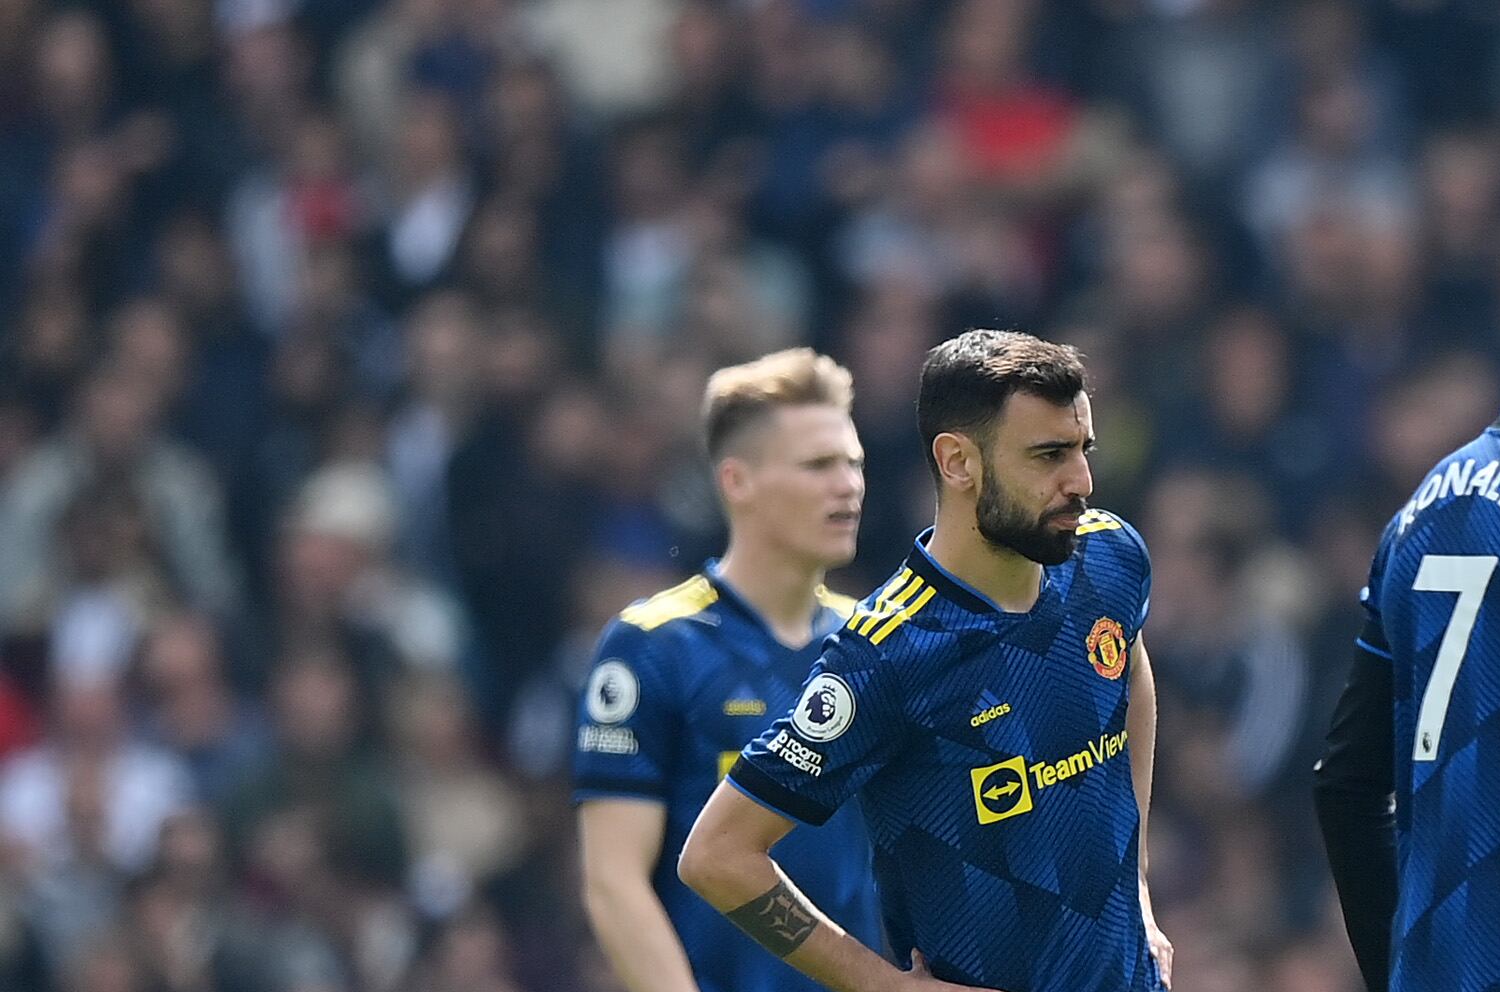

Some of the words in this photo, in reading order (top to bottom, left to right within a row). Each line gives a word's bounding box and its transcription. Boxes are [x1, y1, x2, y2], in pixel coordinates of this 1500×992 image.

[1411, 554, 1499, 762] 7
[970, 702, 1011, 727] adidas
[779, 747, 822, 777] racism
[787, 738, 822, 765] room
